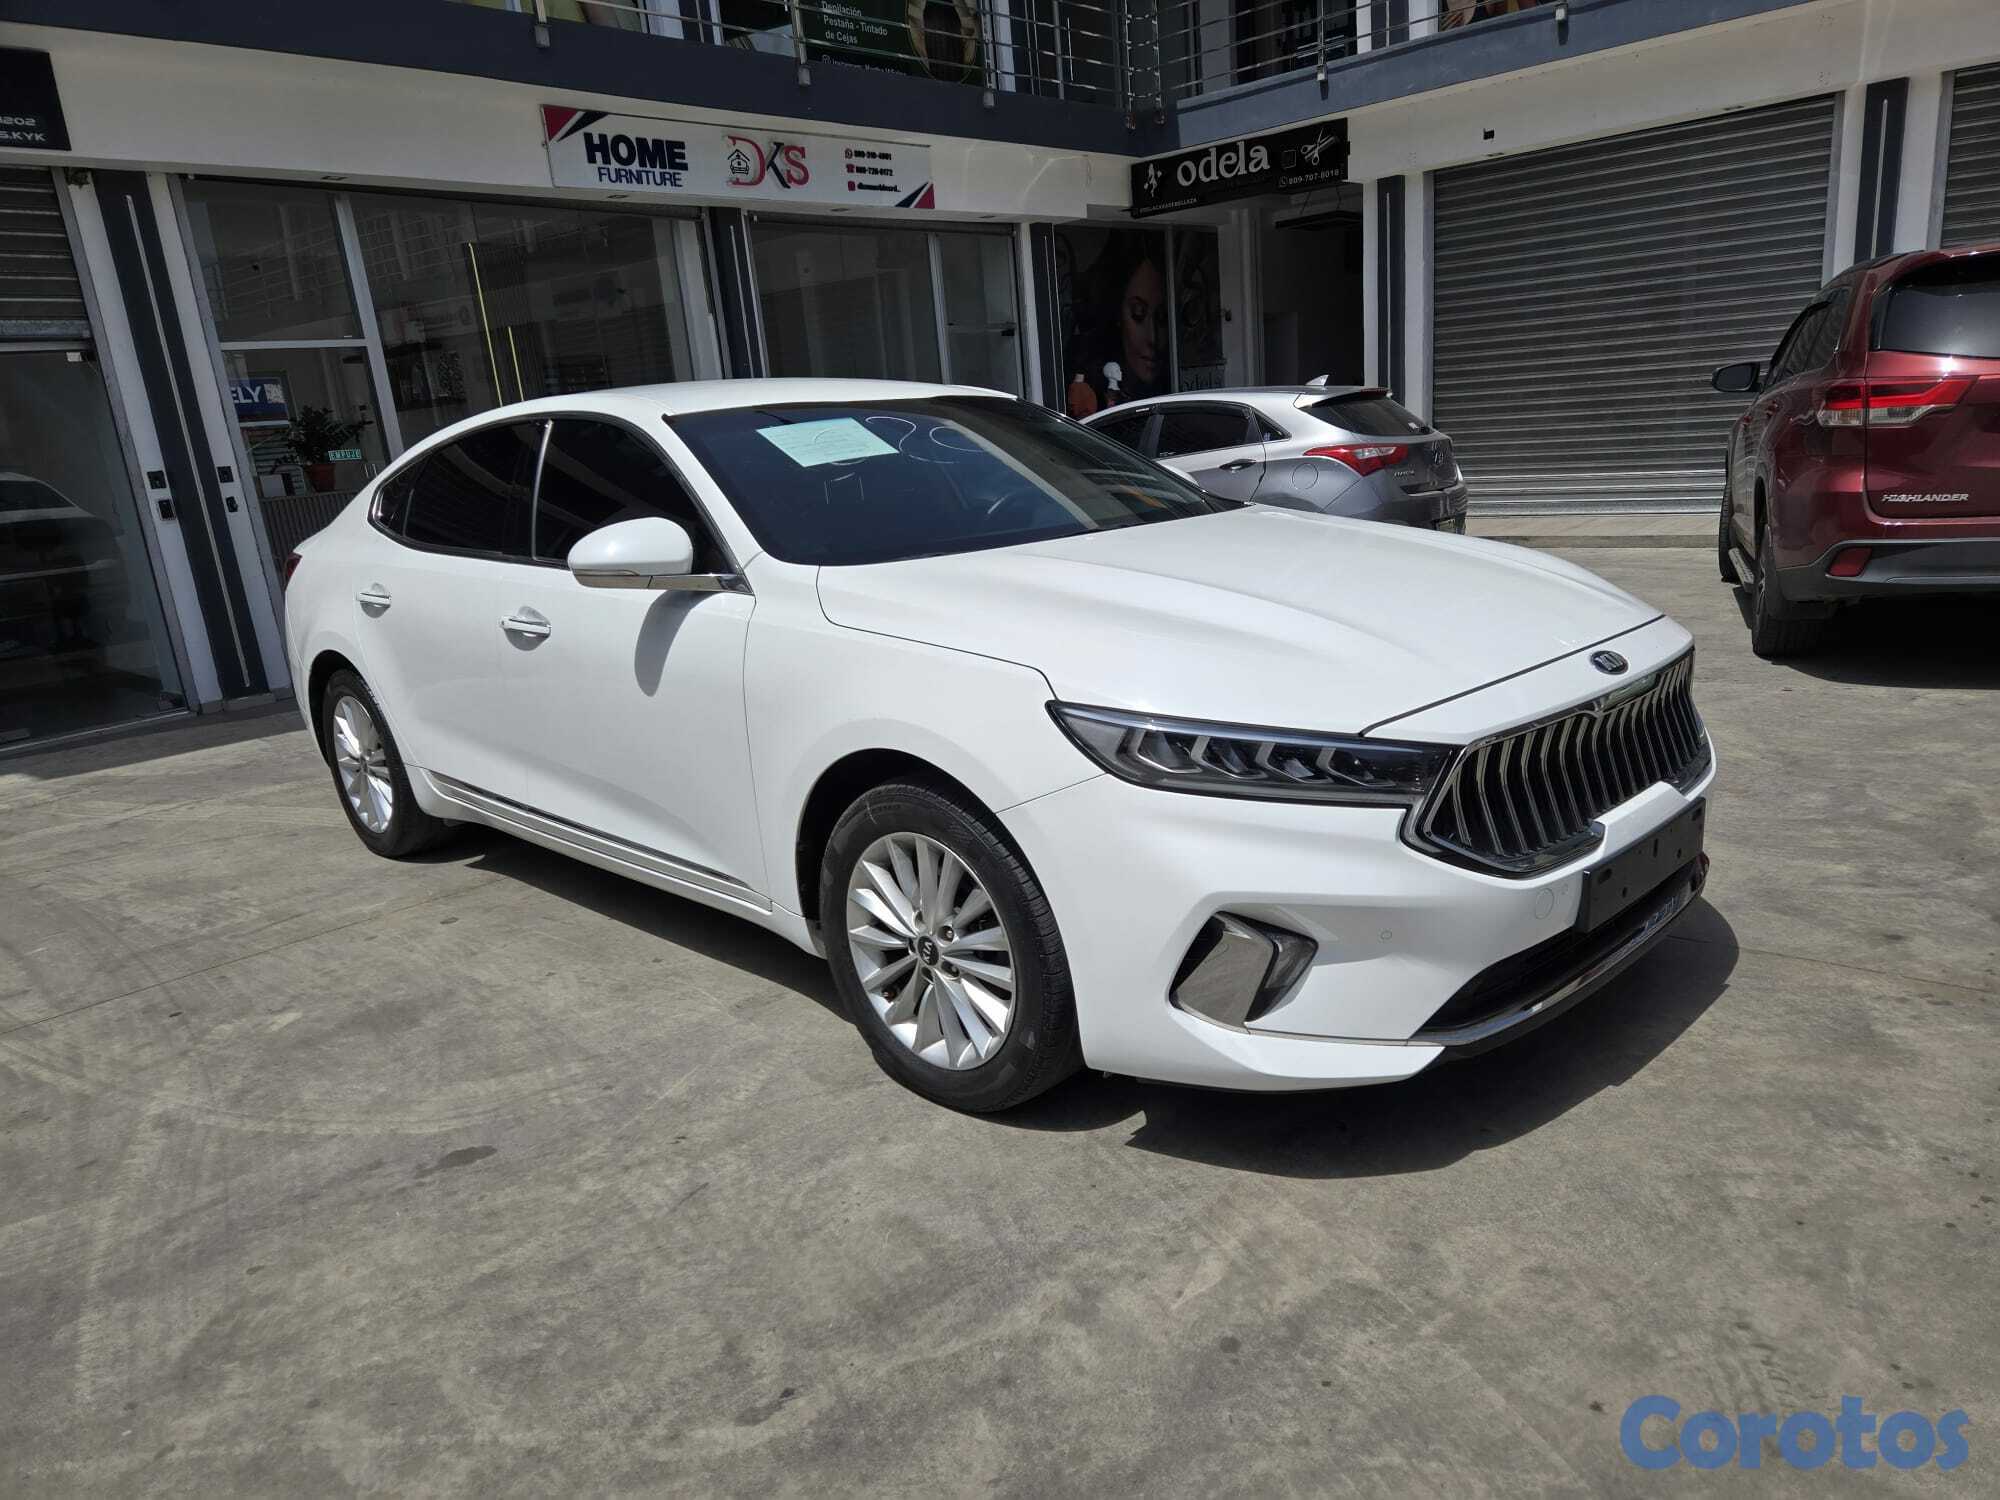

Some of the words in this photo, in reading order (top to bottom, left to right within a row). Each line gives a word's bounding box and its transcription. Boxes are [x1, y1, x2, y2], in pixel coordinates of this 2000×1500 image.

[823, 14, 855, 30] Pestaña
[861, 21, 888, 36] Tintado
[825, 30, 835, 40] de
[836, 31, 858, 45] Cejas
[584, 132, 688, 171] HOME
[1176, 141, 1271, 187] odela
[598, 166, 683, 188] FURNITURE
[1881, 493, 1969, 503] HIGHLANDER
